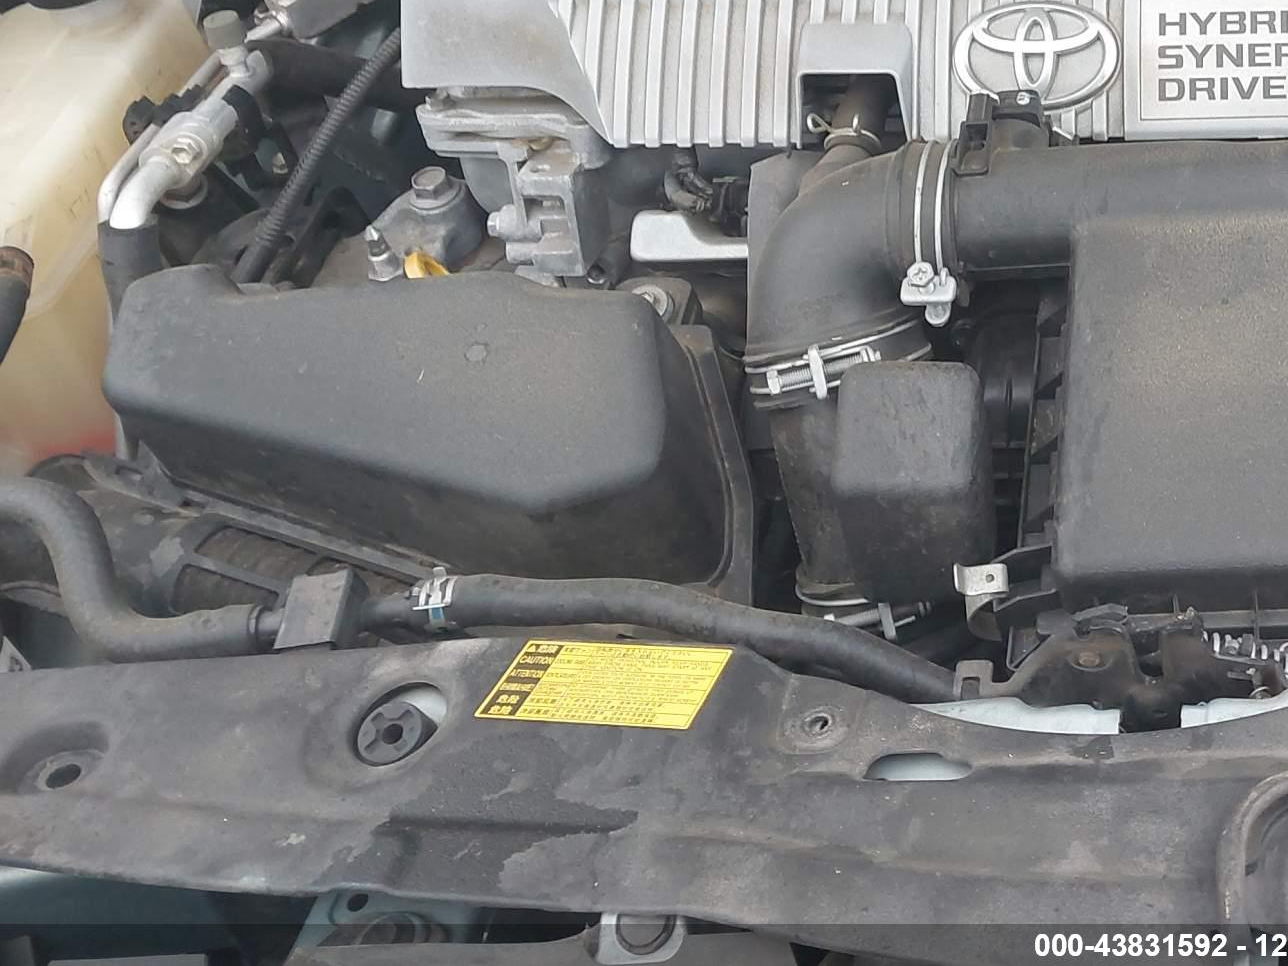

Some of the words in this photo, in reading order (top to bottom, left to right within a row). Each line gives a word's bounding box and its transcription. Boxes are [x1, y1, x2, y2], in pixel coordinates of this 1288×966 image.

[1158, 76, 1287, 101] DRIVE
[519, 655, 554, 665] CAUTION
[510, 669, 544, 678] ATTENTION
